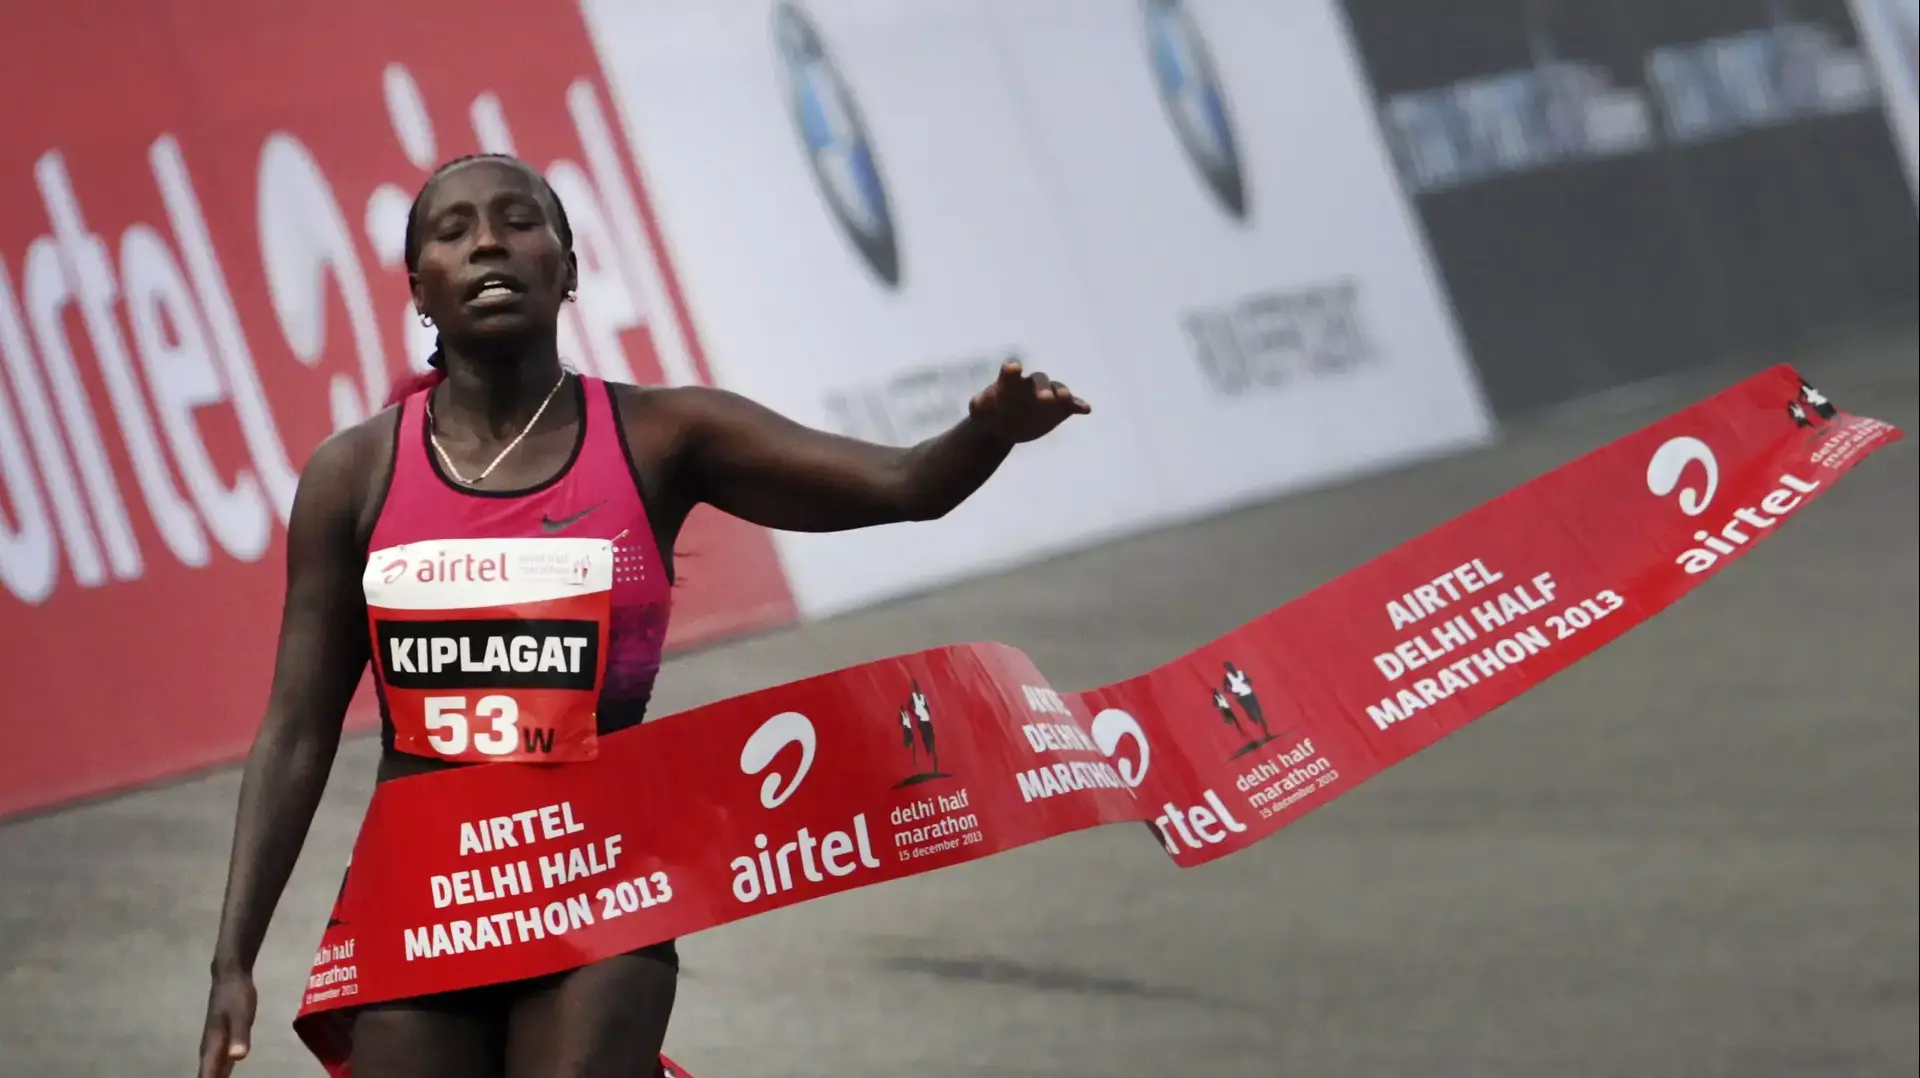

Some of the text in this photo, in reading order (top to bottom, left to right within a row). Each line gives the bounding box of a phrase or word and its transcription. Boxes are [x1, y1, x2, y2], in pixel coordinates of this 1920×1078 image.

[0, 132, 300, 605] irtel
[1675, 473, 1820, 575] airtel
[416, 551, 510, 583] airtel
[1386, 558, 1504, 631] AIRTEL
[1373, 571, 1557, 682] DELHI HALF
[389, 635, 587, 674] KIPLAGAT
[1365, 589, 1625, 731] MARATHON 2013
[1016, 762, 1127, 803] MARATHO
[1236, 737, 1315, 792] delhi half
[1248, 757, 1331, 808] marathon
[459, 801, 584, 856] AIRTEL
[890, 788, 969, 825] delhi half
[894, 813, 978, 847] marathon
[1155, 789, 1247, 854] rtel
[430, 834, 623, 909] DELHI HALF
[730, 812, 880, 903] airtel
[899, 830, 983, 861] 15 december 2013
[404, 871, 673, 961] MARATHON 2013
[332, 938, 355, 960] half
